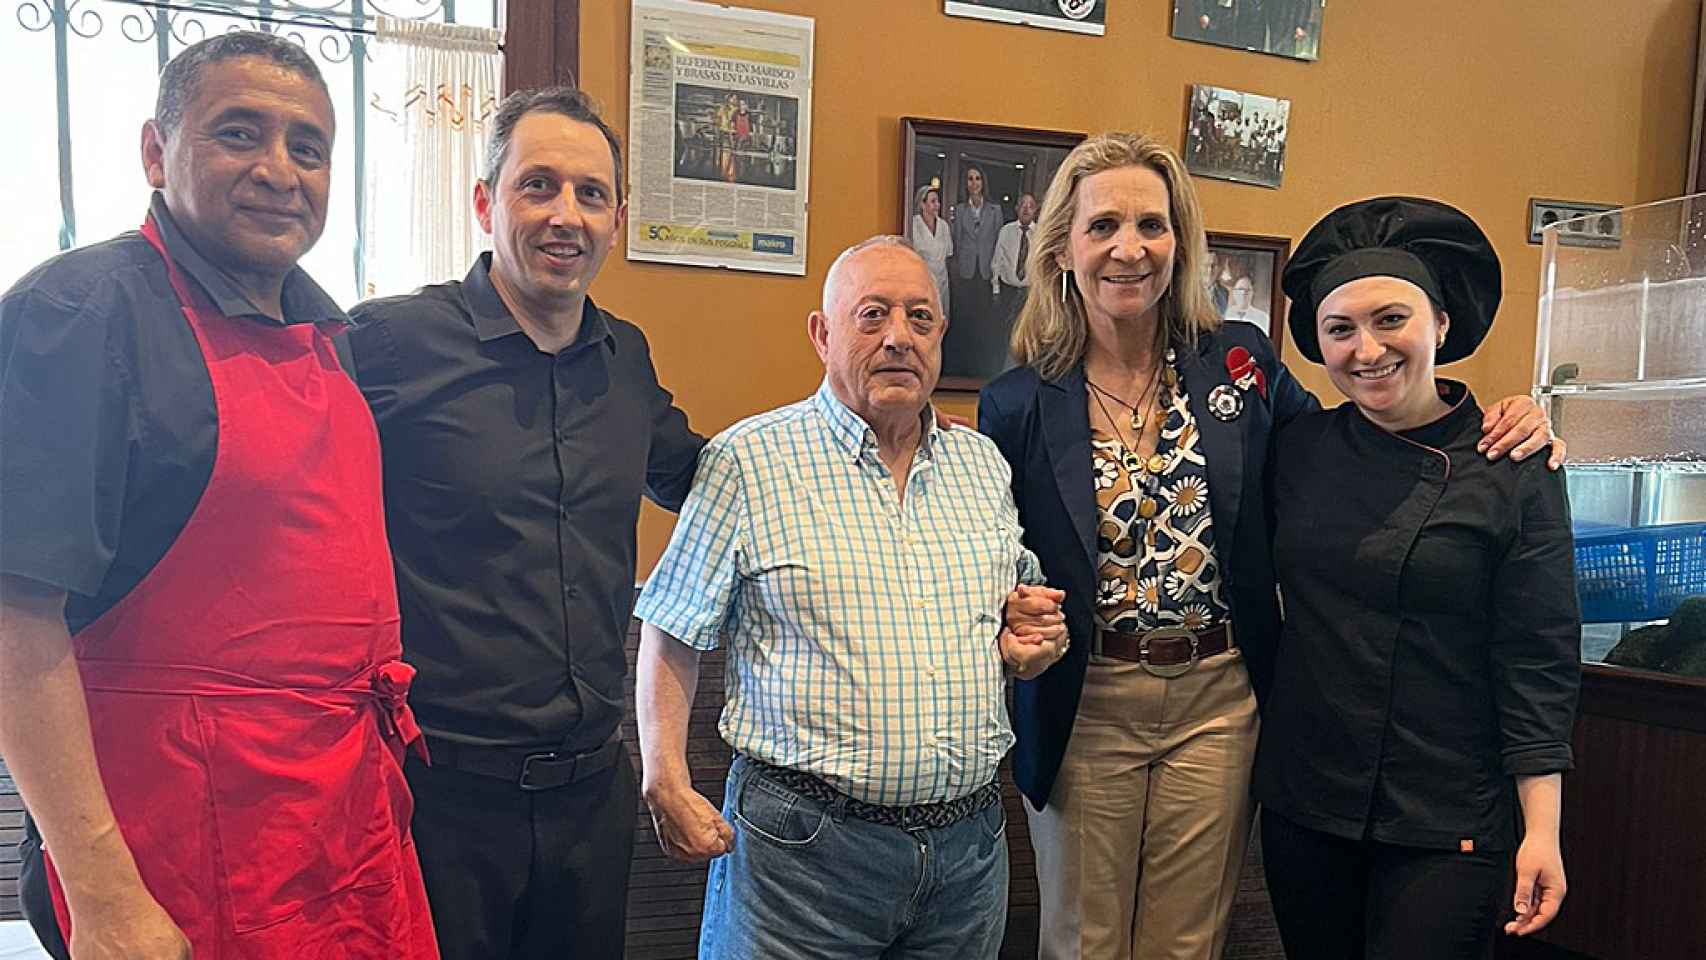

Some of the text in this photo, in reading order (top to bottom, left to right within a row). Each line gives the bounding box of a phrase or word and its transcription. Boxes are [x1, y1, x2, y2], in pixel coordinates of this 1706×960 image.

[676, 56, 795, 80] REFERENTE EN MARISCO
[676, 66, 683, 76] Y
[684, 69, 721, 81] BRASAS
[722, 72, 738, 83] EN
[754, 78, 790, 89] VILLAS
